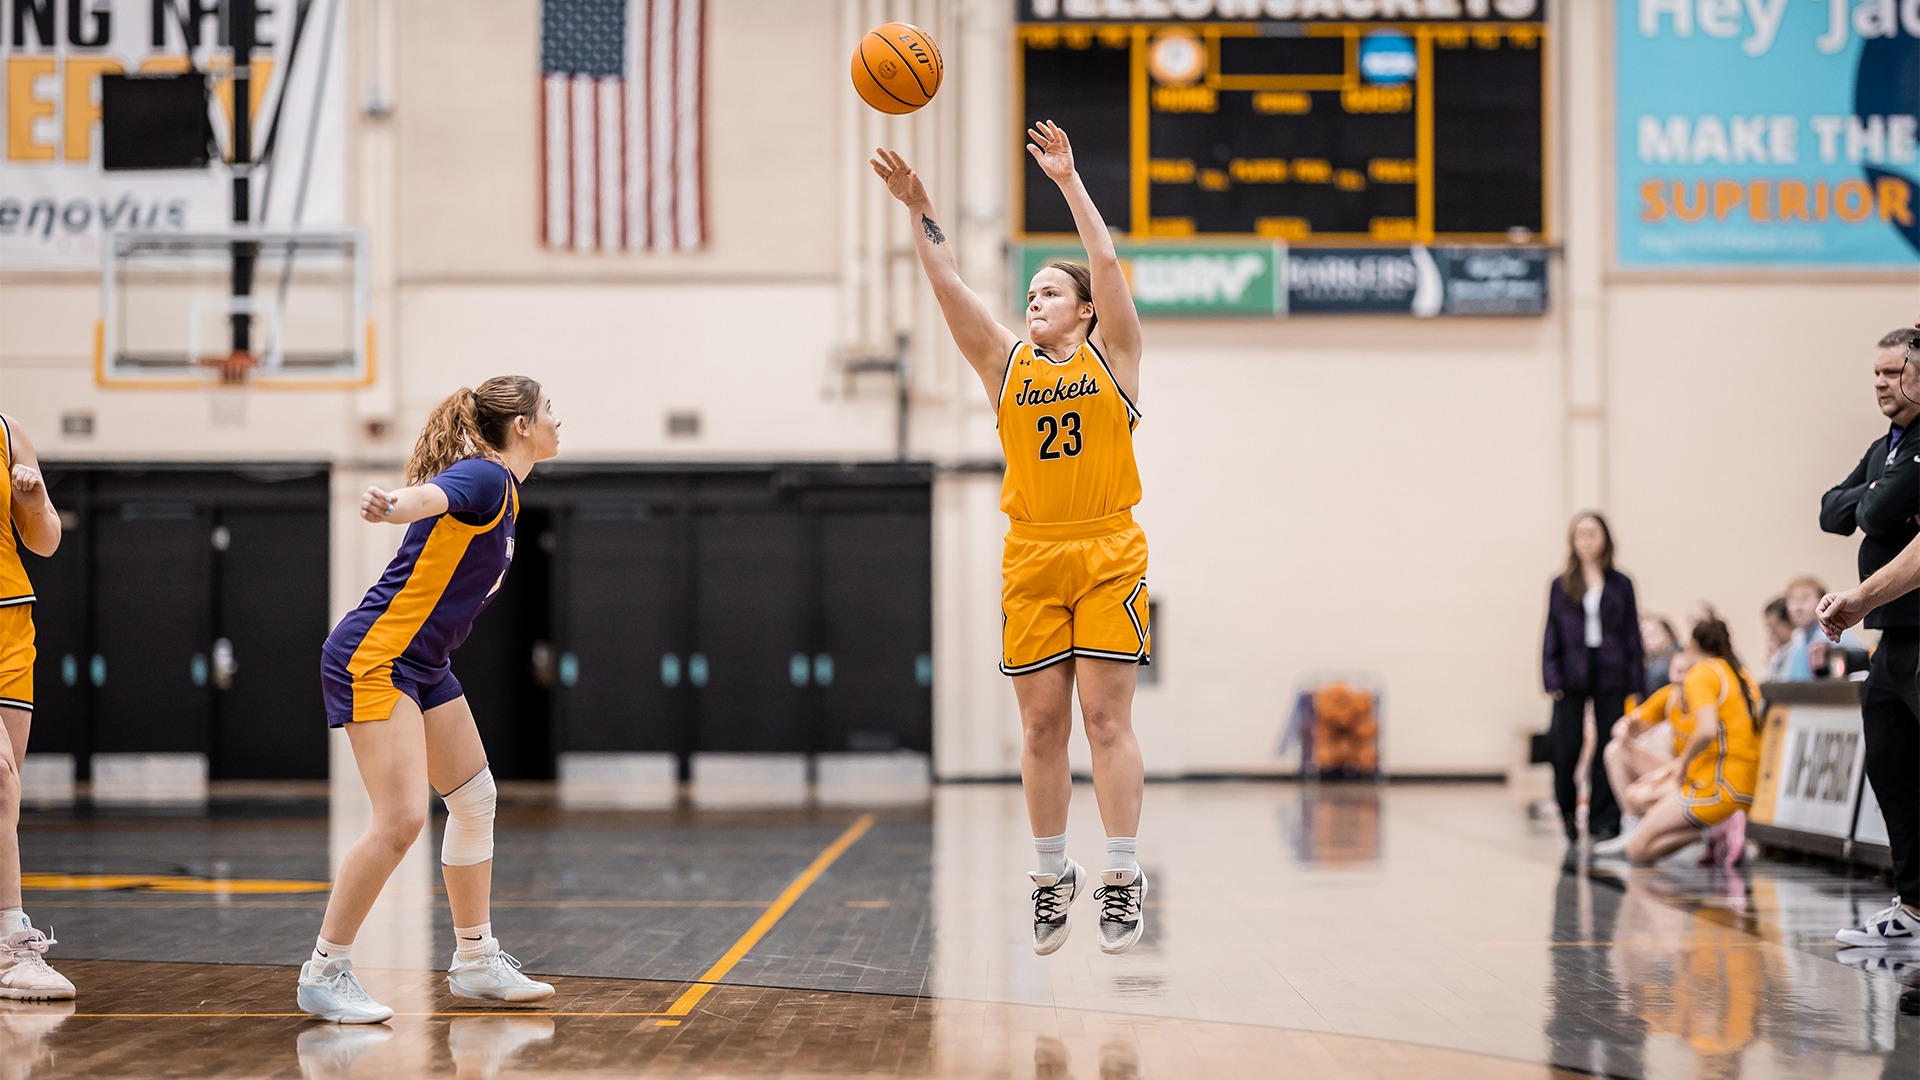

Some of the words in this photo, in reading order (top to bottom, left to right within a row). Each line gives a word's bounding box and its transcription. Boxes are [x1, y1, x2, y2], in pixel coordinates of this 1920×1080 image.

[899, 34, 929, 64] EVO
[1639, 0, 1790, 57] Hey
[1638, 114, 1798, 163] MAKE
[1809, 114, 1917, 163] THE
[1640, 178, 1914, 226] SUPERIOR
[1016, 373, 1100, 406] Jackets
[1037, 411, 1082, 461] 23
